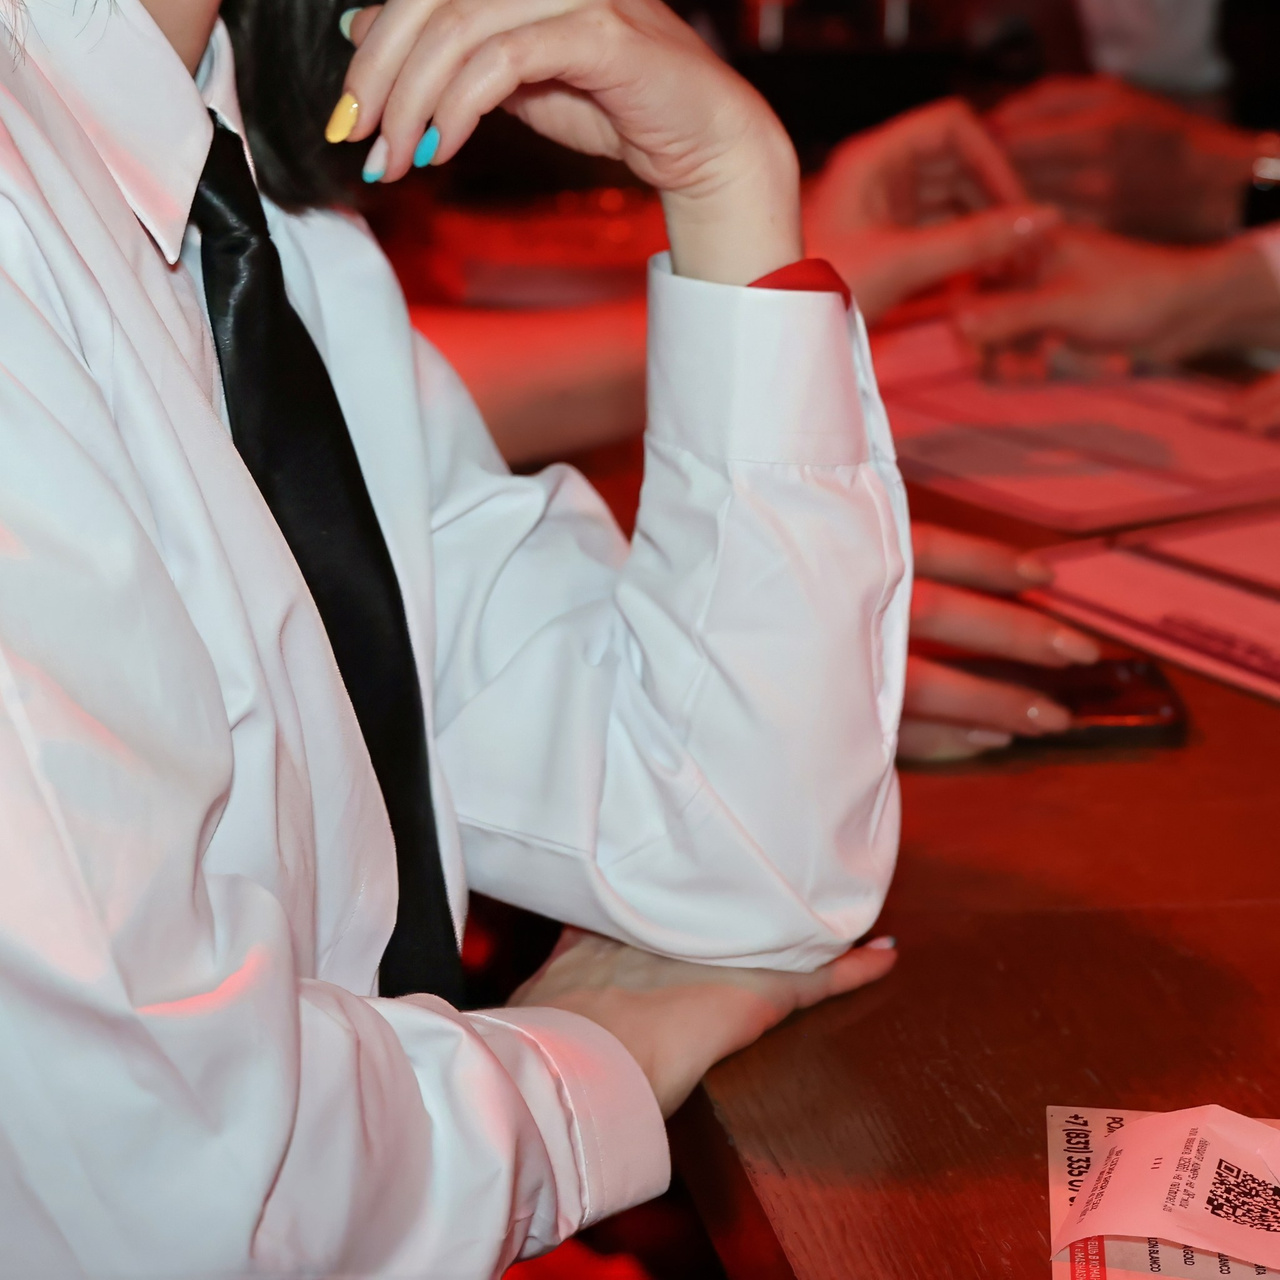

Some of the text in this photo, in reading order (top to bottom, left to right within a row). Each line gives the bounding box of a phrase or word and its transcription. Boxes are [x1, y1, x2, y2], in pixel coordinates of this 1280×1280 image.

[1065, 1114, 1089, 1126] +7
[1062, 1128, 1094, 1154] (831)
[1183, 1249, 1196, 1266] GOLD
[1217, 1253, 1231, 1275] LANCO
